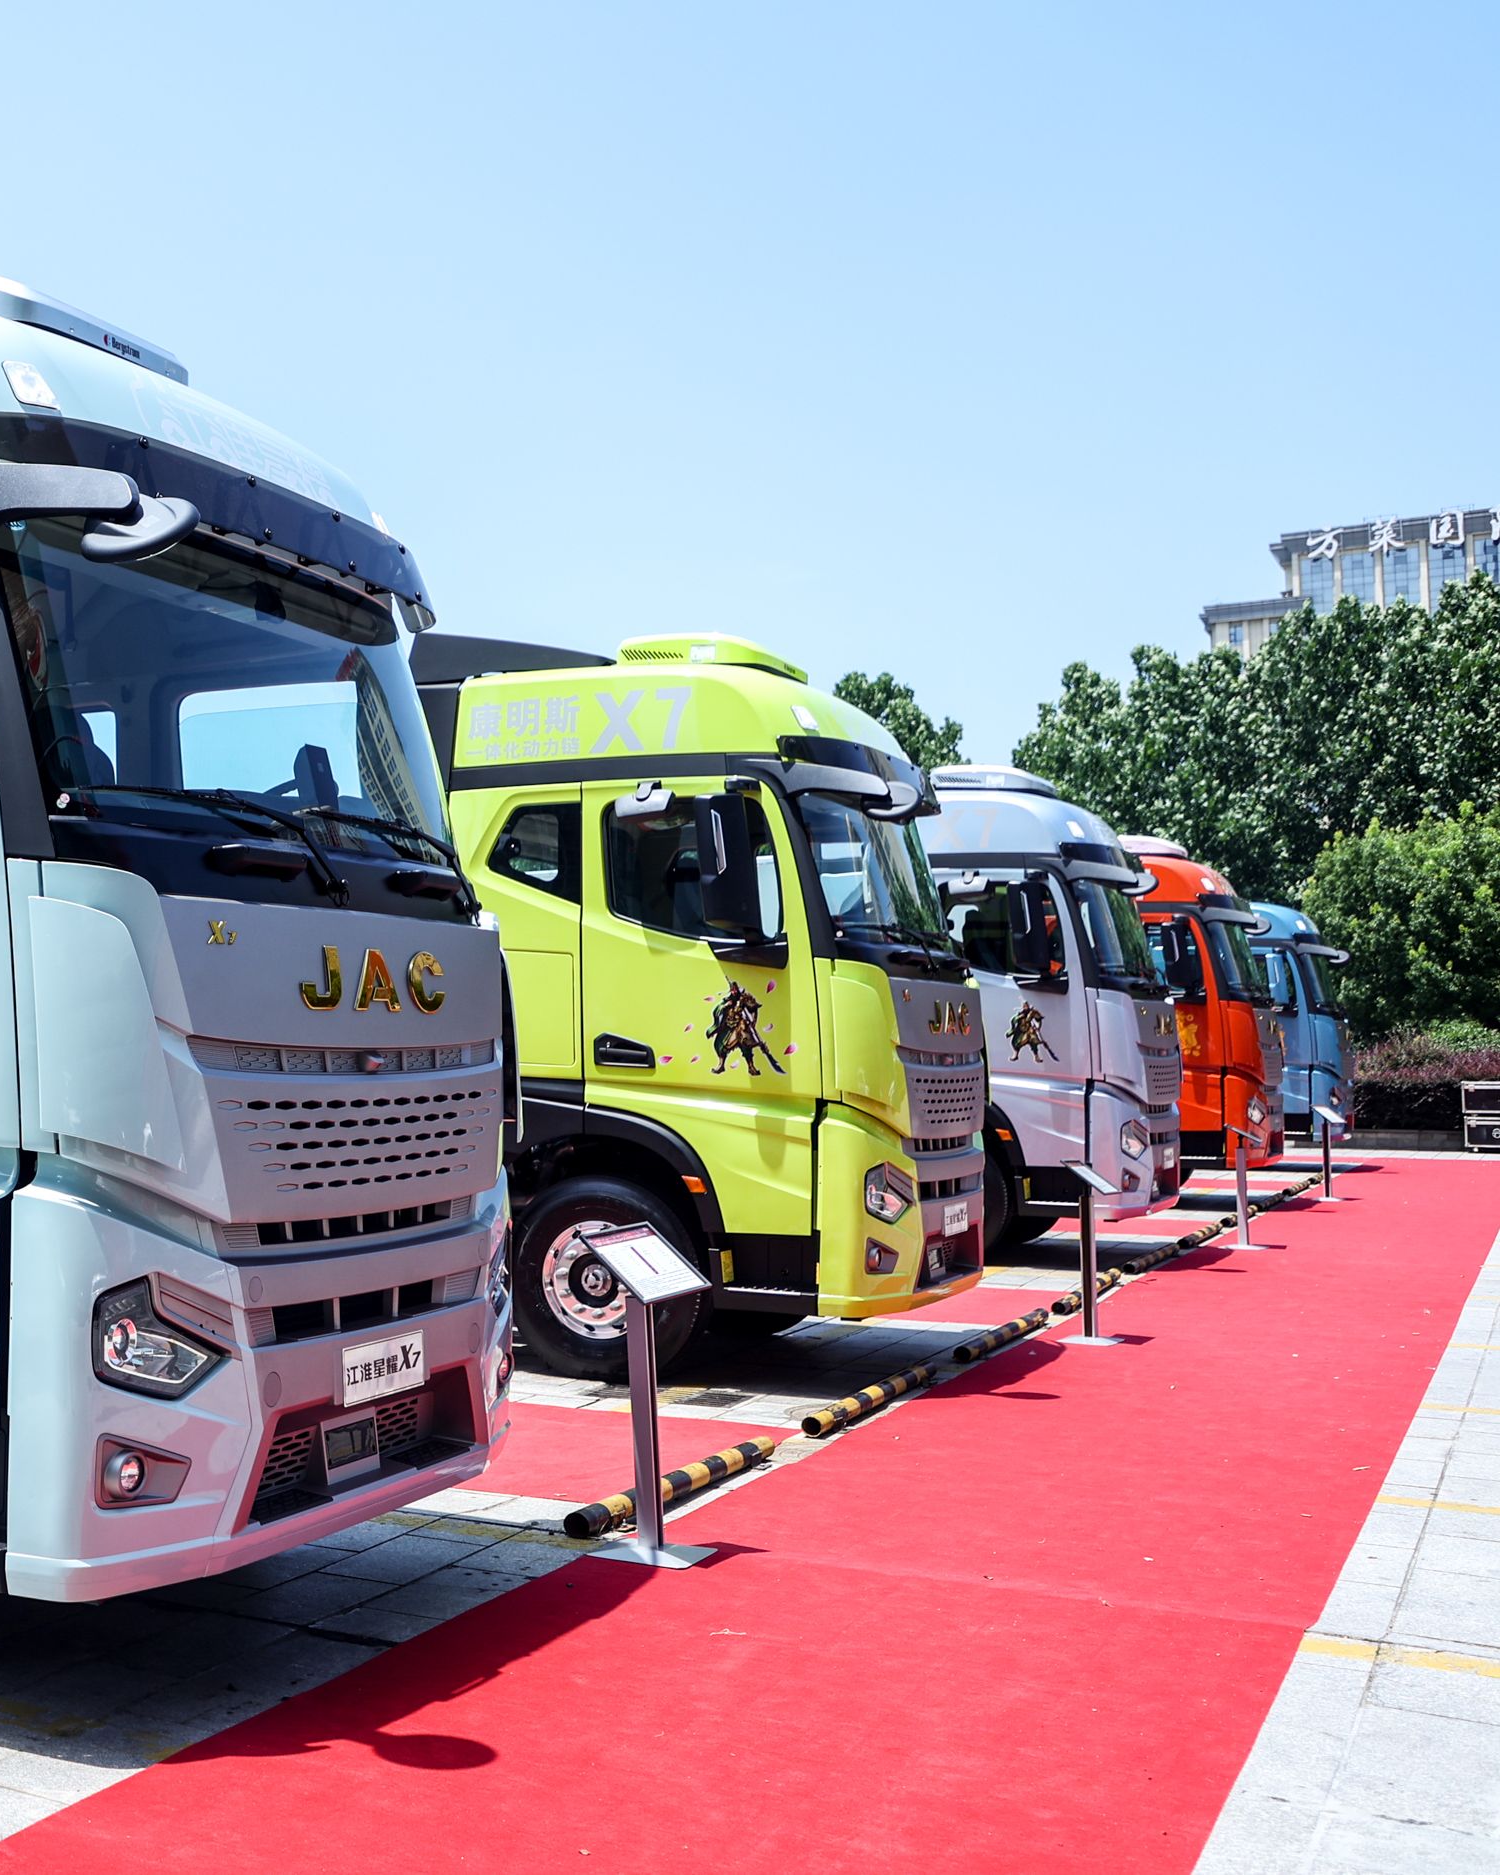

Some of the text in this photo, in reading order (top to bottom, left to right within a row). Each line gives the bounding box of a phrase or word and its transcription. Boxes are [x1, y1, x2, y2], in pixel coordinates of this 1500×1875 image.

[468, 686, 692, 753] 康明斯 X7
[466, 738, 580, 760] 一体化动力链
[928, 808, 998, 849] X7
[207, 919, 238, 945] X7
[299, 944, 446, 1014] JAC
[929, 1000, 971, 1036] JAC
[346, 1343, 421, 1386] 江淮星耀X7
